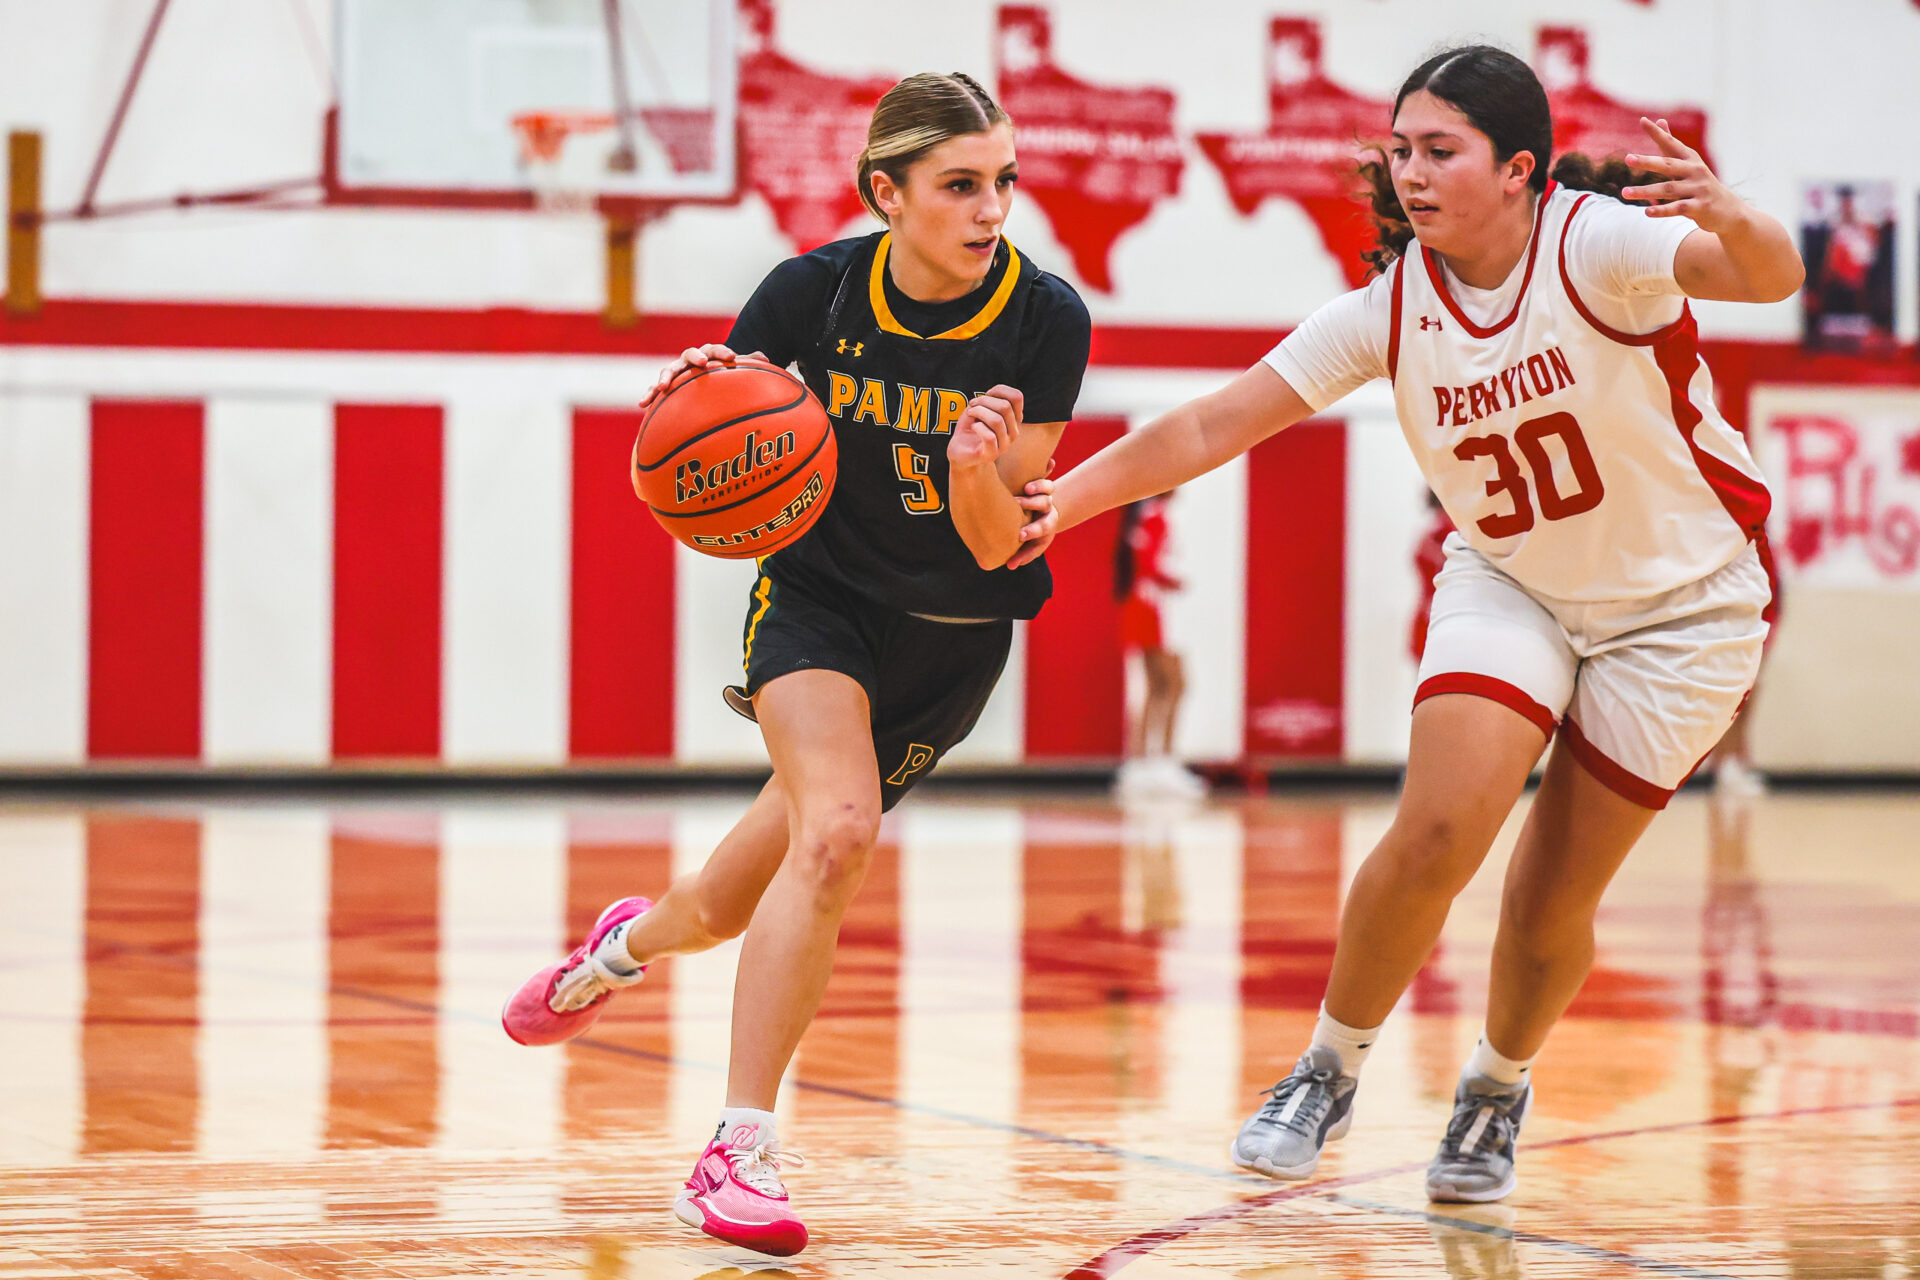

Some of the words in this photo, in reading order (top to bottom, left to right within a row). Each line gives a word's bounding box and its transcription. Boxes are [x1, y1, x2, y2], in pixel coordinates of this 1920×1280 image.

[826, 369, 989, 435] PAMP
[676, 430, 796, 504] Baden
[702, 464, 780, 505] PERFECTION
[892, 443, 945, 515] 5
[1453, 411, 1605, 539] 30
[886, 742, 934, 785] P
